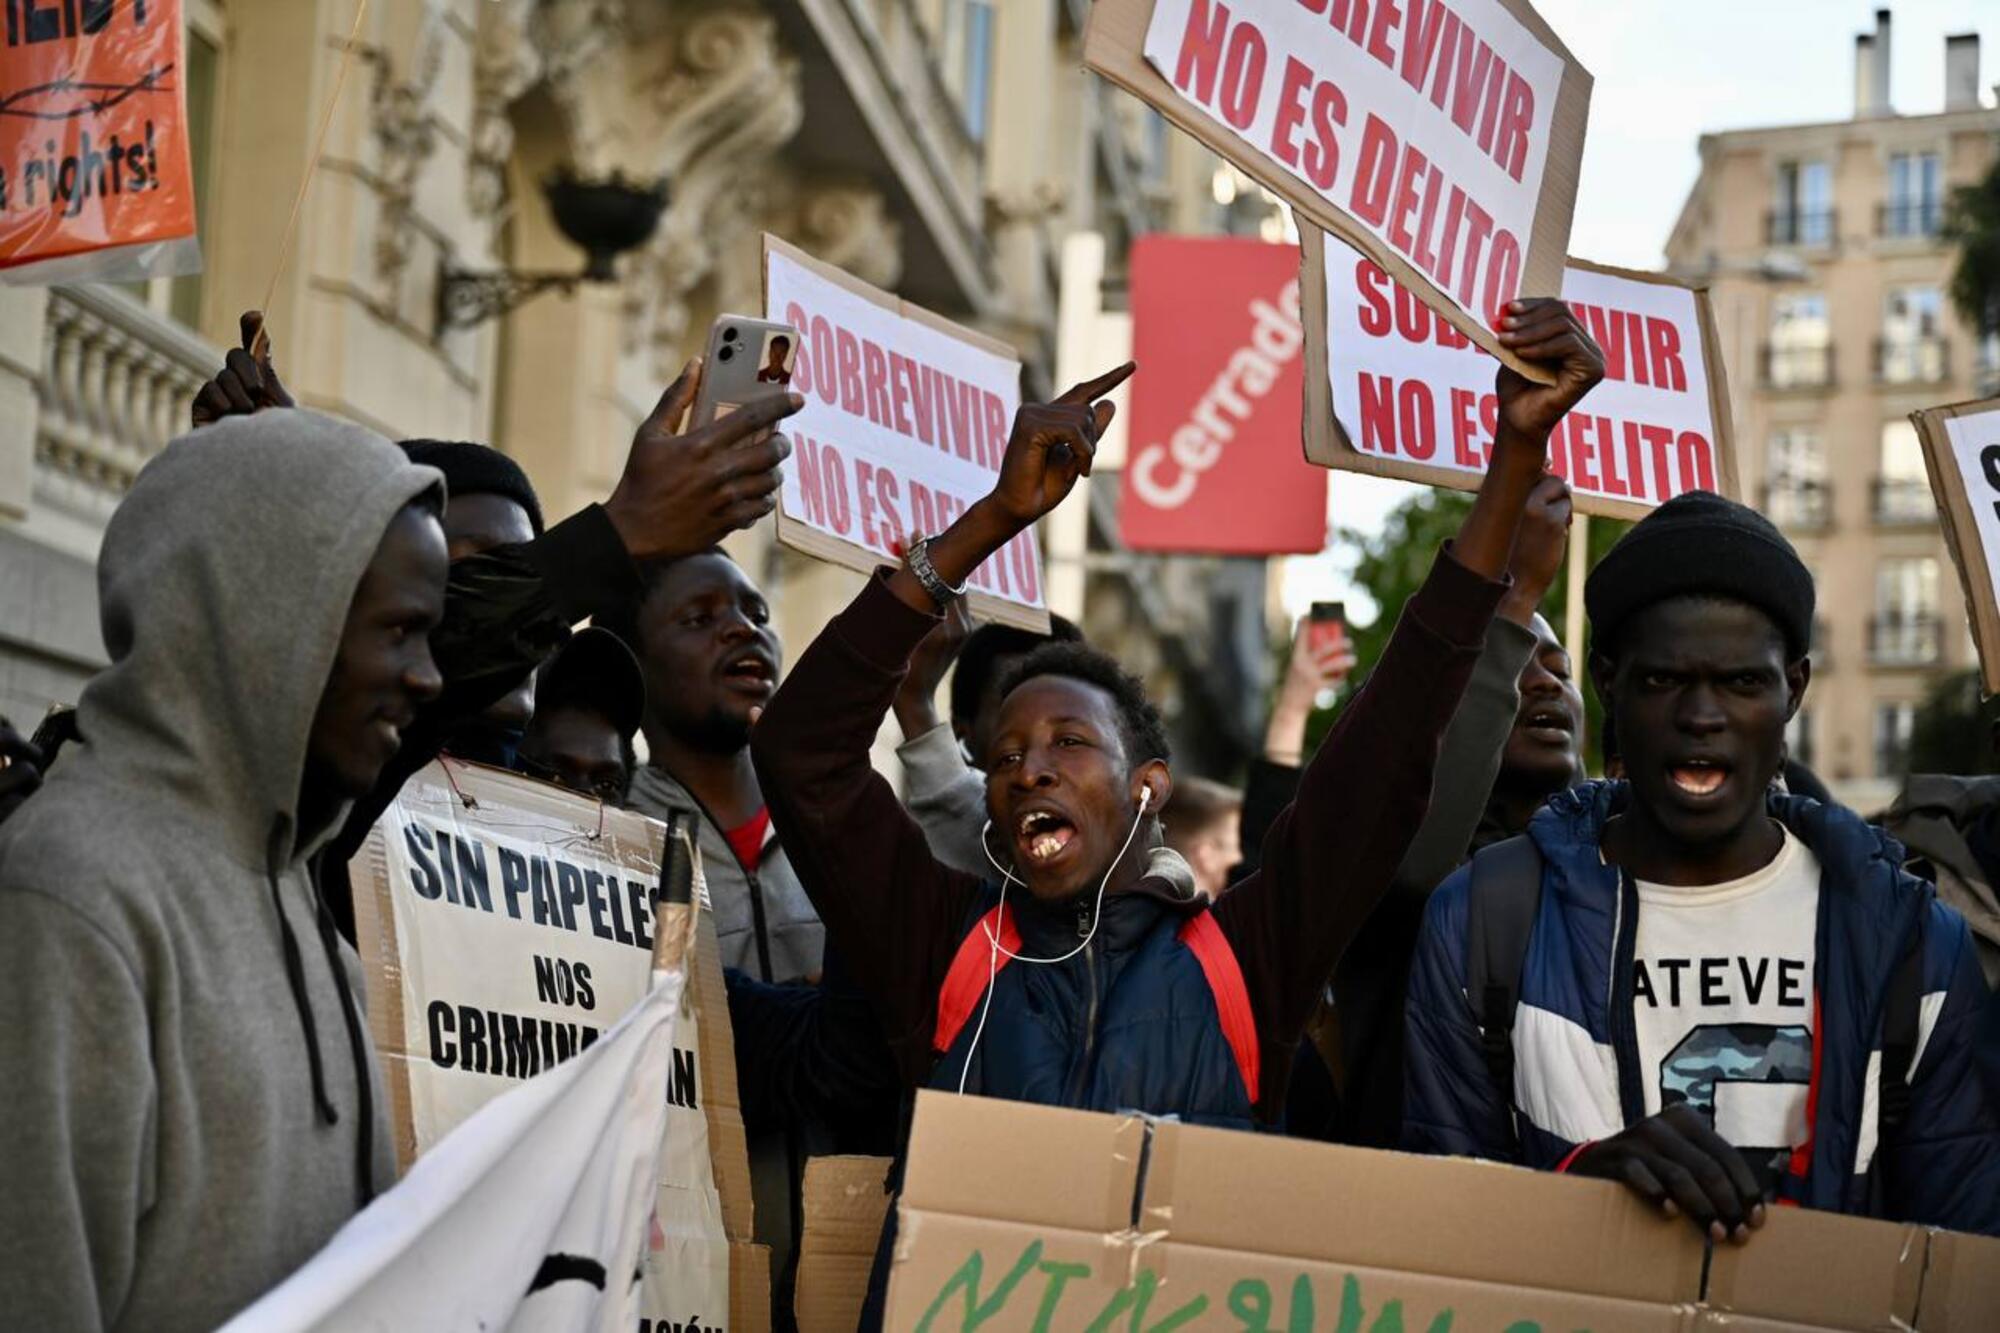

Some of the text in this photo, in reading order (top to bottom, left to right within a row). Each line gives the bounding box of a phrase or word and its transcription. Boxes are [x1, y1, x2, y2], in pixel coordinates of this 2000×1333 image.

[25, 119, 158, 217] rights!
[1174, 0, 1522, 334] NO ES DELITO
[786, 302, 1007, 472] SOBREVIVIR
[1358, 371, 1436, 460] NO
[794, 432, 852, 536] NO
[855, 459, 902, 557] ES
[405, 822, 493, 912] SIN
[533, 954, 596, 1011] NOS
